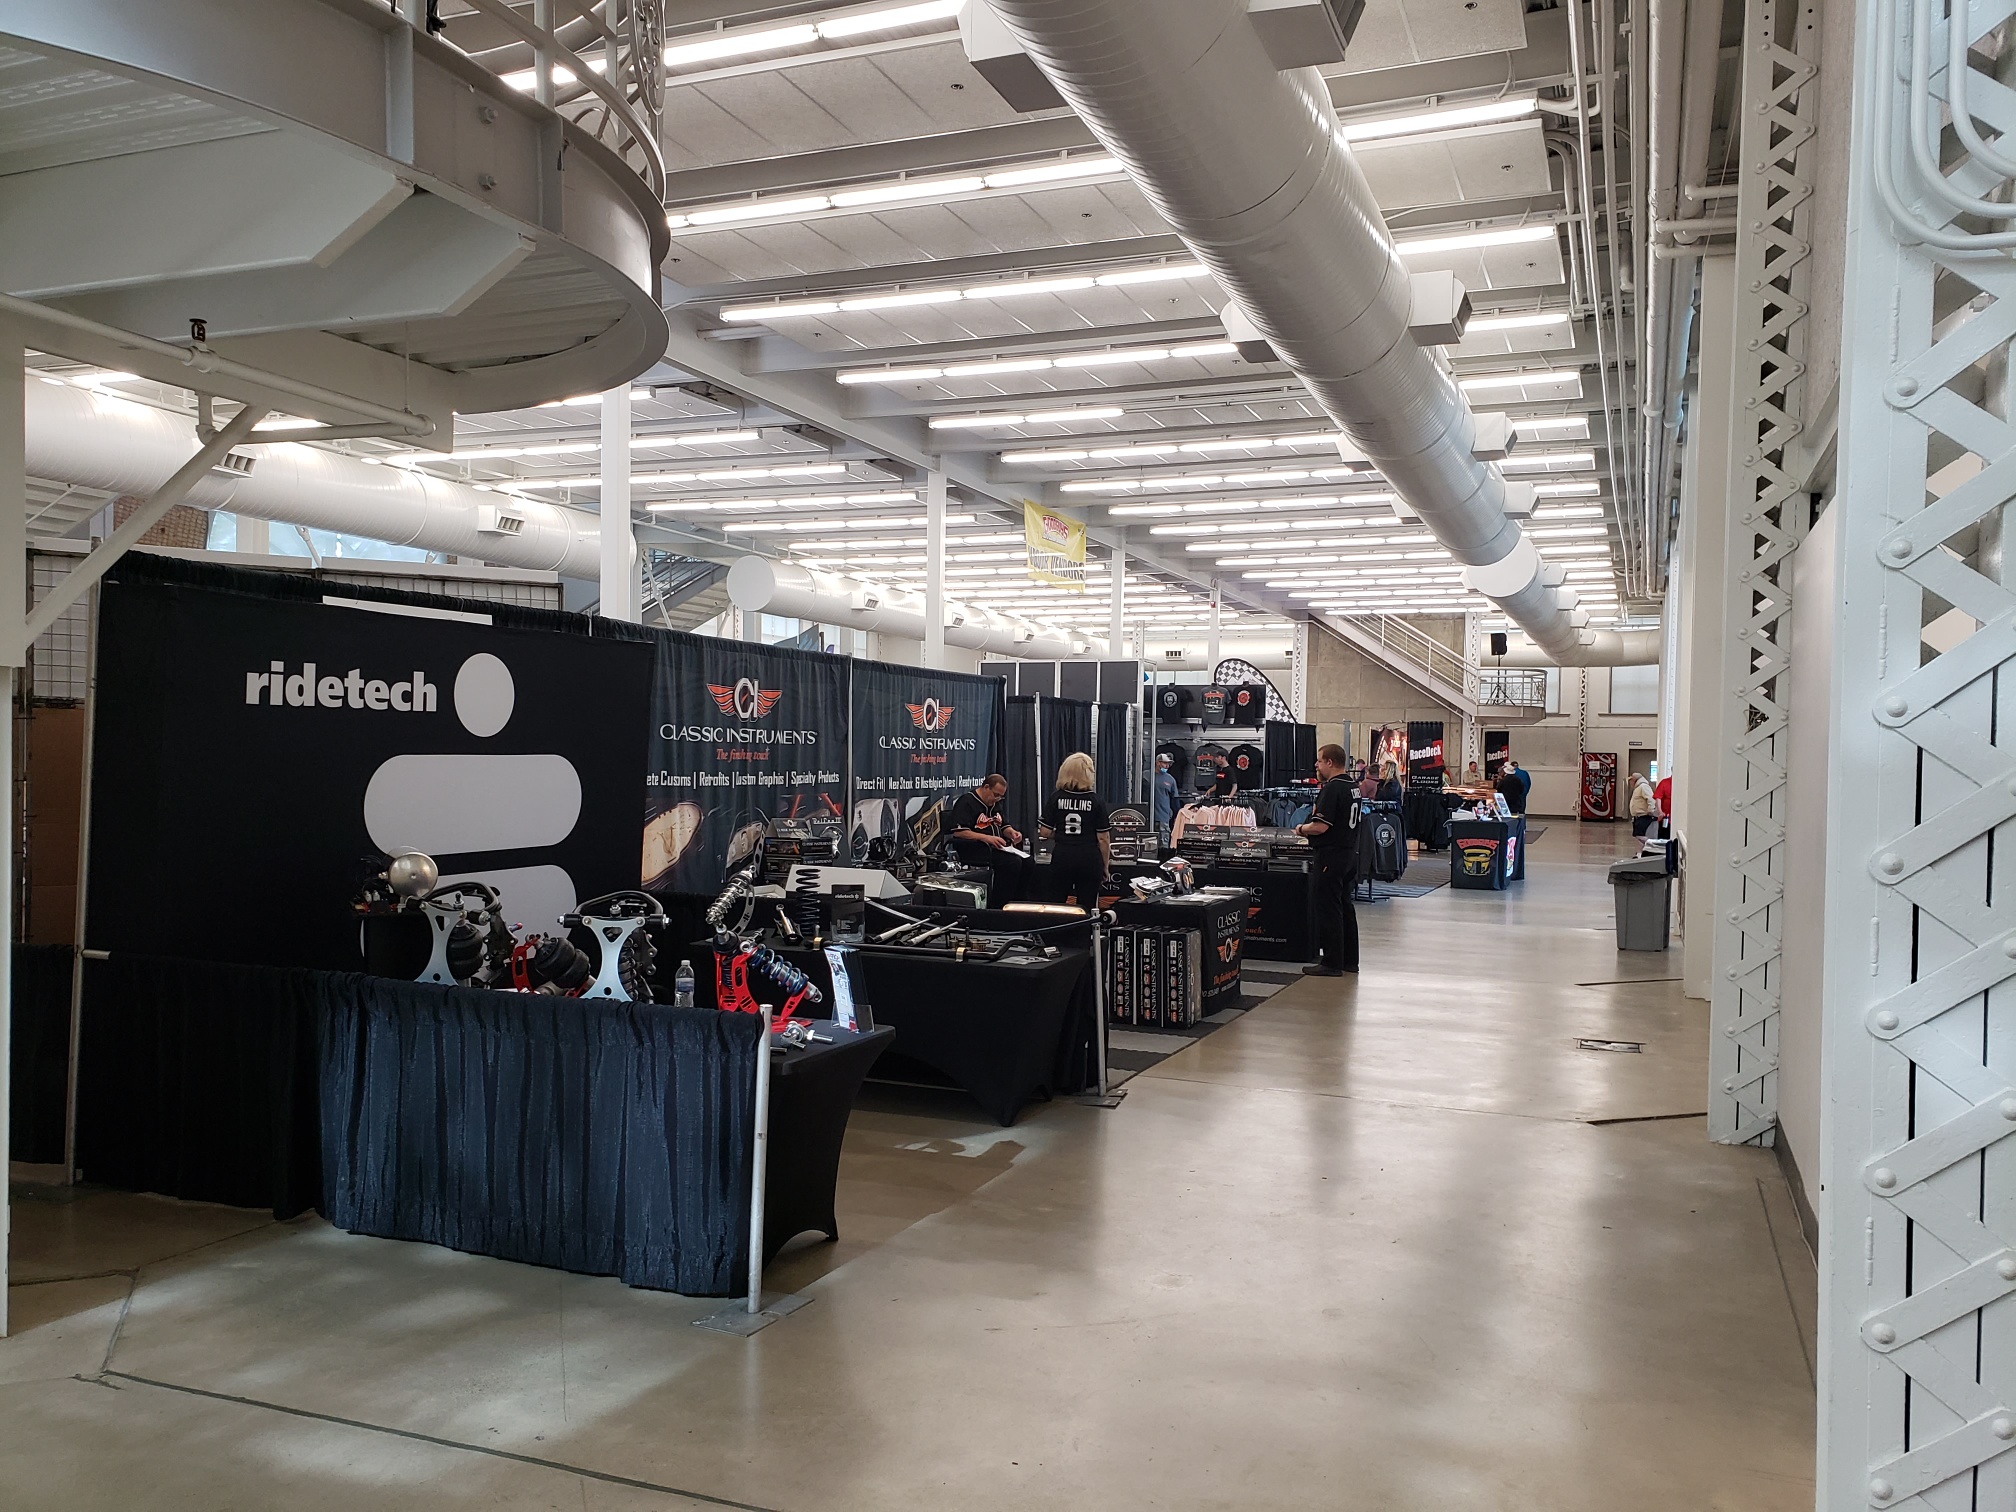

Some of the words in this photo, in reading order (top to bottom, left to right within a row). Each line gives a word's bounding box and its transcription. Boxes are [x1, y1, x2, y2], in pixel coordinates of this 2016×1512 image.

[246, 660, 437, 712] ridetech
[660, 724, 723, 742] CLASSIC
[726, 727, 816, 745] INSTRUMENTS
[879, 736, 916, 750] CLASSIC
[920, 738, 976, 750] INSTRUMENTS
[716, 748, 728, 761] The
[1410, 744, 1442, 760] RaceDeck
[699, 772, 730, 786] Retrofits
[1058, 798, 1092, 812] MULLINS
[1065, 812, 1082, 835] 8
[1217, 910, 1241, 928] CLASSIC
[1245, 926, 1263, 934] ouch.
